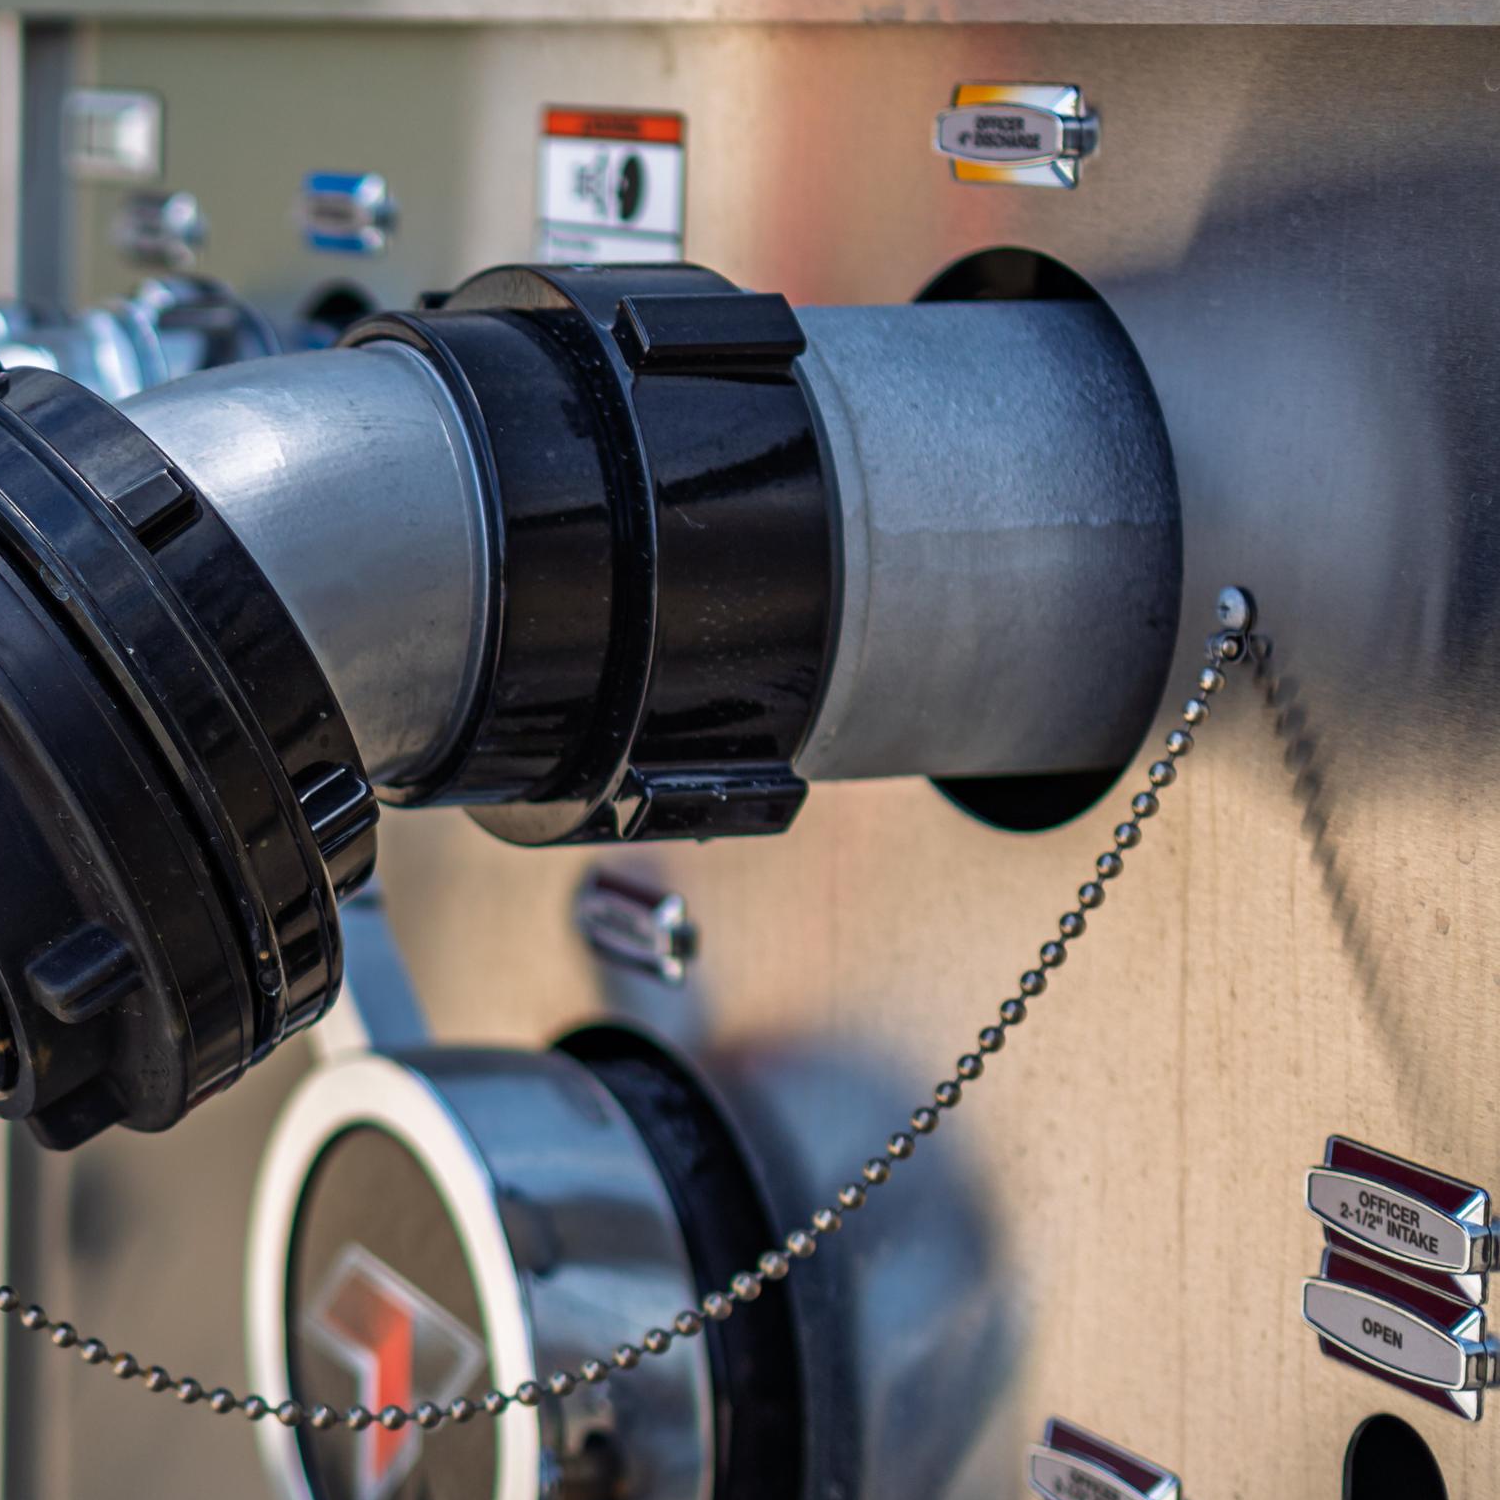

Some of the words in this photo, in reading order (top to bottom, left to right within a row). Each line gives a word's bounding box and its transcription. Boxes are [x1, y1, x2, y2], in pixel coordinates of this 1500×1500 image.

[1340, 1202, 1383, 1231] 2-1/2"
[1387, 1218, 1439, 1255] INTAKE
[1358, 1190, 1420, 1229] OFFICER
[1362, 1317, 1403, 1349] OPEN
